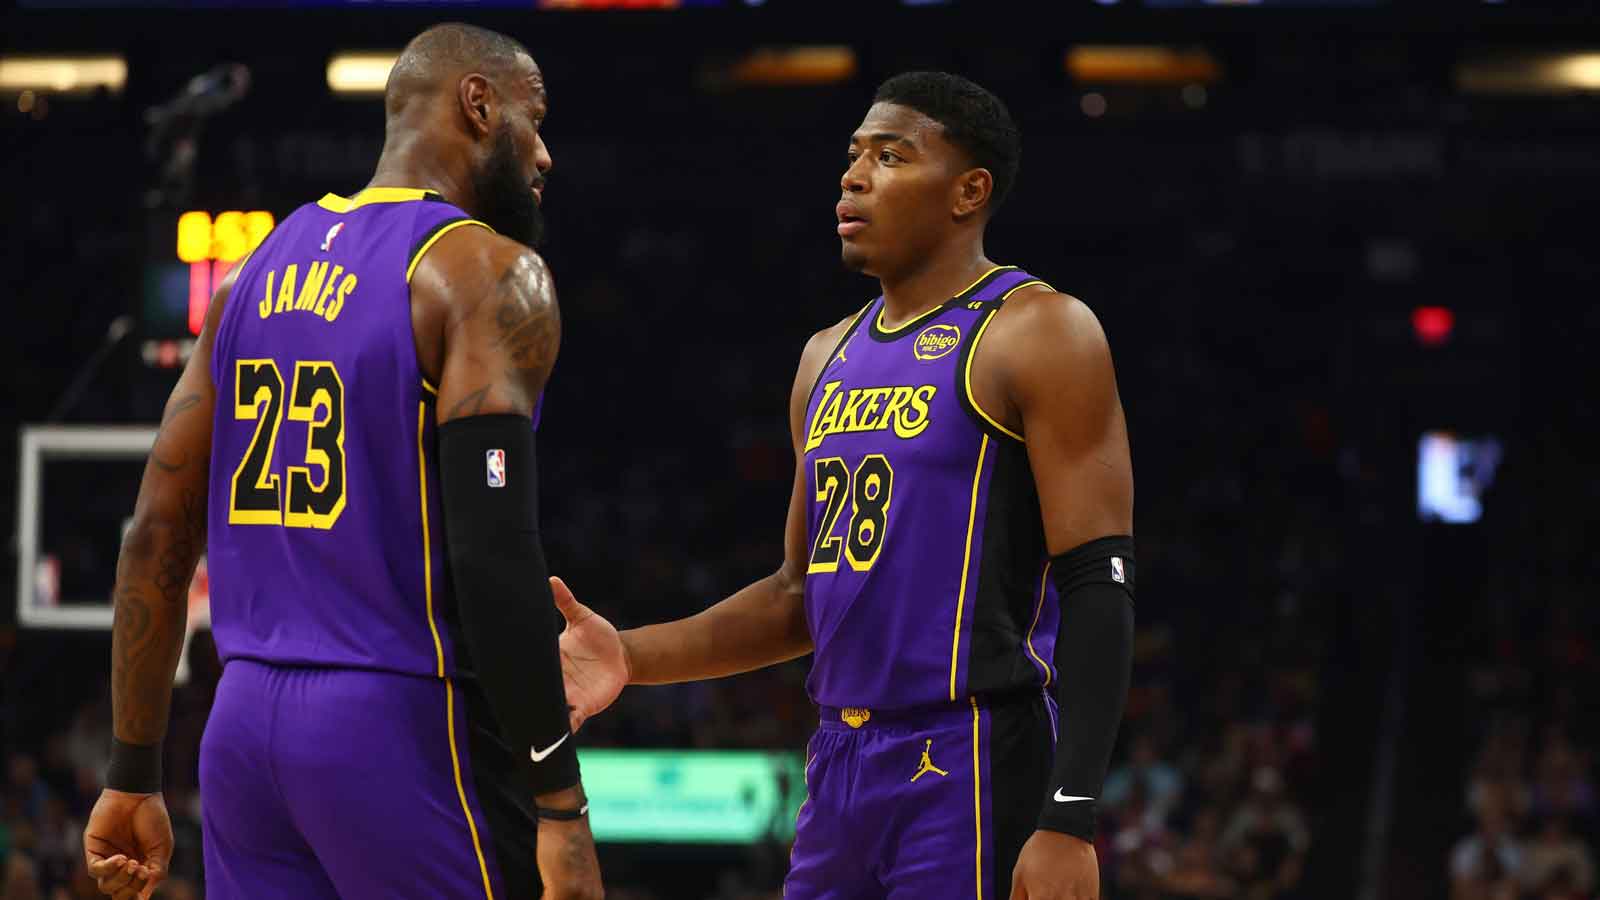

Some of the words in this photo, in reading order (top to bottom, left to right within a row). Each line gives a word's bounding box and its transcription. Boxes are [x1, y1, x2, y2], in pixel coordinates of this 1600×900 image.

[259, 261, 357, 322] JAMES
[920, 333, 956, 349] bibigo
[229, 359, 346, 529] 23
[804, 381, 937, 453] LAKERS
[807, 454, 893, 574] 28
